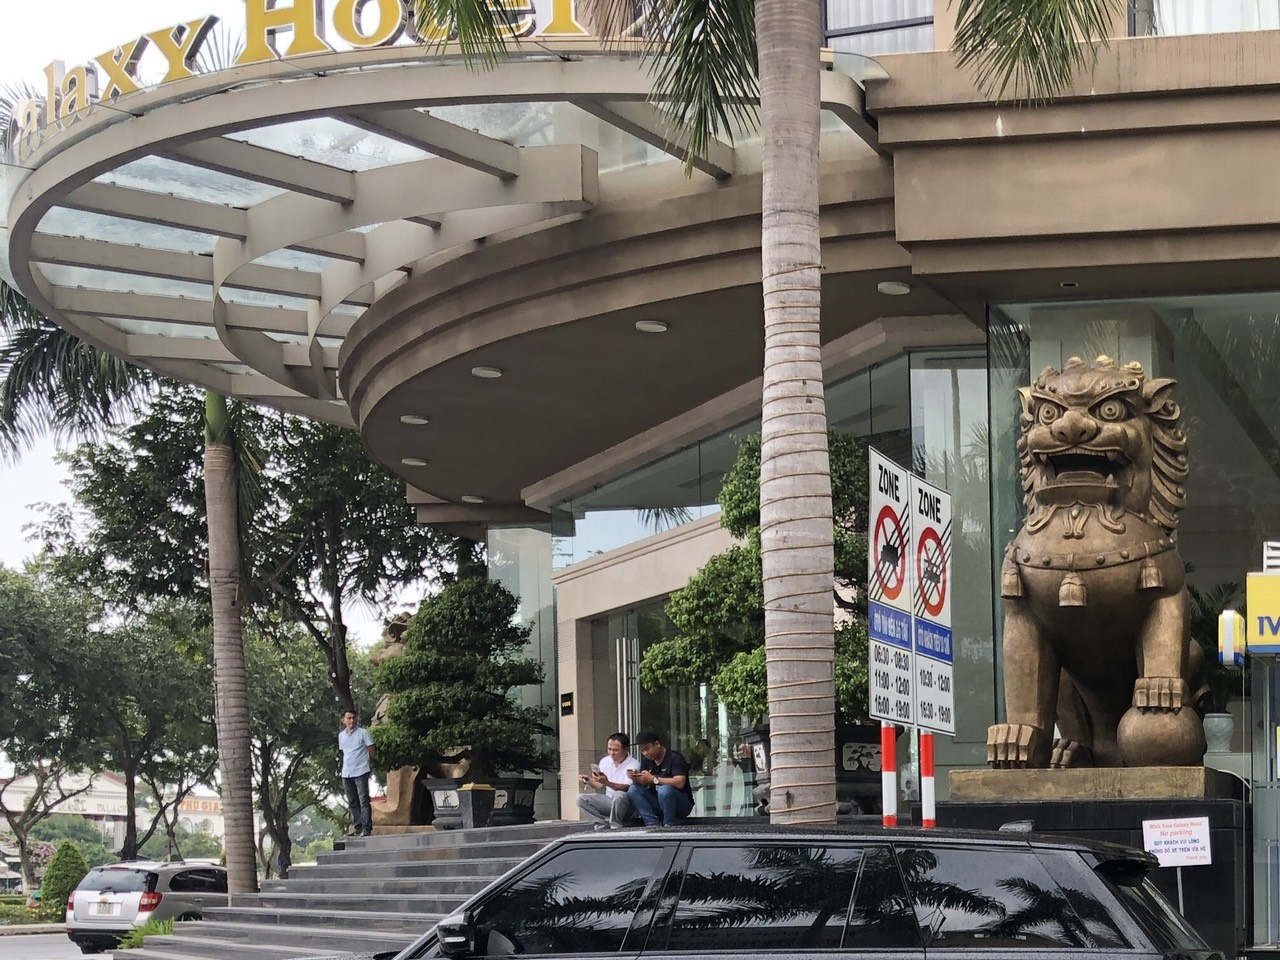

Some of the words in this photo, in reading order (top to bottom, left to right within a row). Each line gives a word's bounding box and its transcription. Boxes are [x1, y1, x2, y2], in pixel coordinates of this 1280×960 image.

[878, 464, 900, 503] ZONE
[918, 488, 941, 524] ZONE
[874, 644, 889, 666] 06:30
[895, 651, 909, 671] 08:30
[875, 668, 889, 690] 11:00
[895, 676, 909, 696] 12:00
[920, 668, 932, 688] 10:30
[938, 674, 950, 693] 12:00
[875, 694, 889, 715] 16:00
[895, 700, 910, 719] 19:00
[920, 701, 933, 720] 16:30
[938, 705, 951, 724] 19:00
